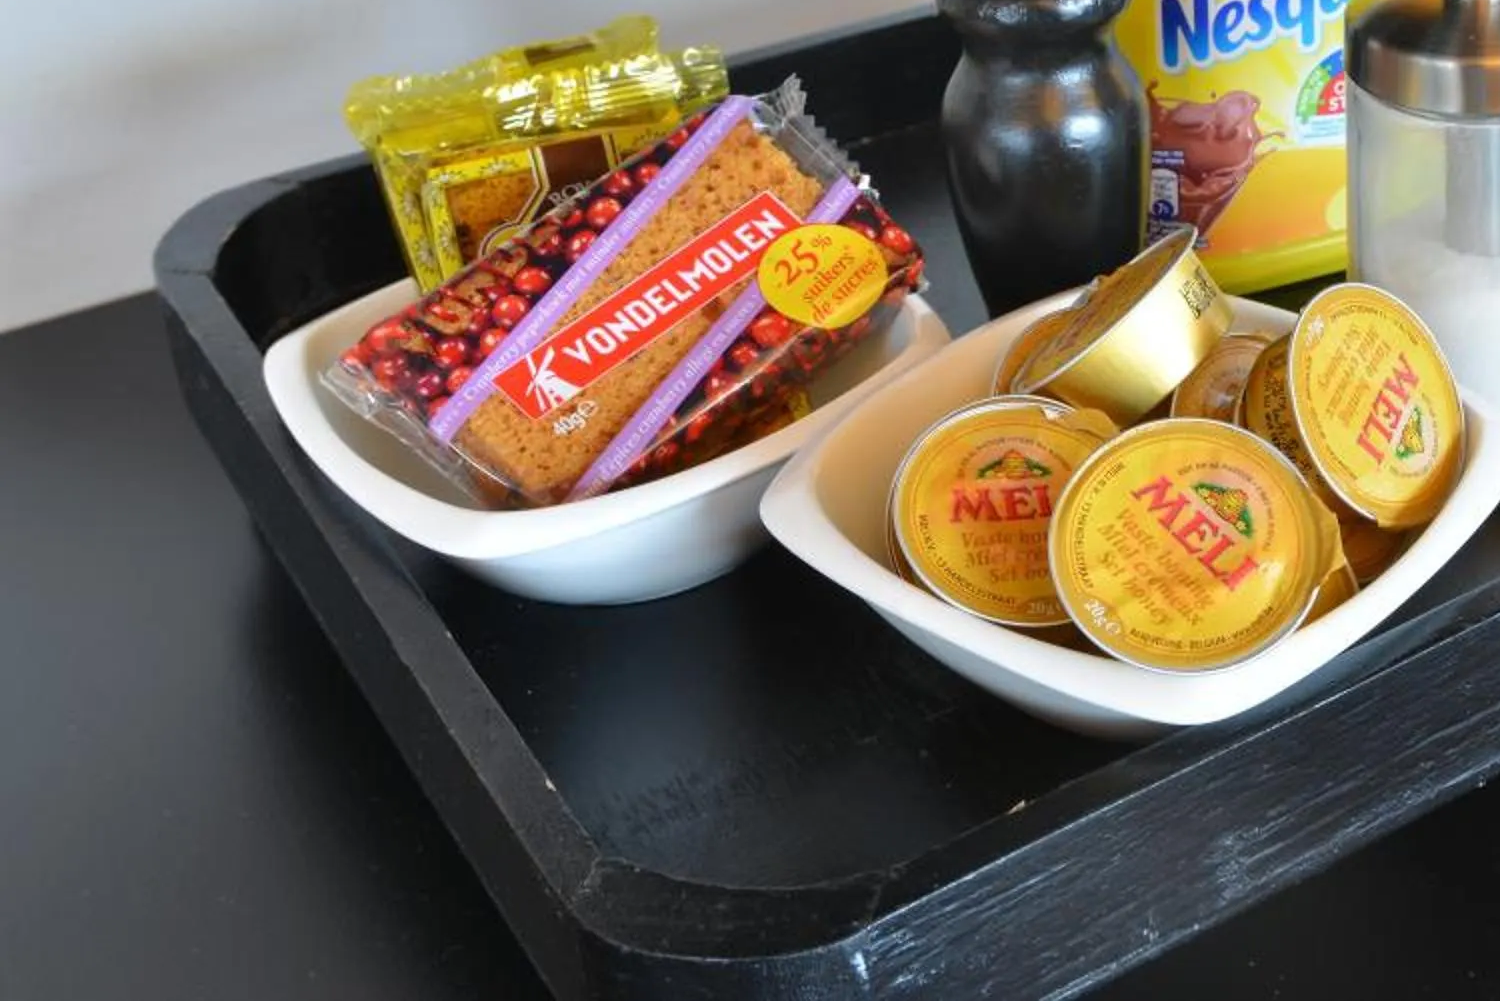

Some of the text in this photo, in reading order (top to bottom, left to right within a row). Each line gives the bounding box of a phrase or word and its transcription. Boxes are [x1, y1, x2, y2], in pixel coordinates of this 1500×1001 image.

[562, 209, 787, 364] VONDELMOLEN
[1354, 351, 1422, 466] MELI
[1095, 519, 1140, 561] Miel
[1115, 506, 1162, 554] Vaste
[1129, 474, 1260, 593] MELI
[1095, 548, 1173, 627] Set honey
